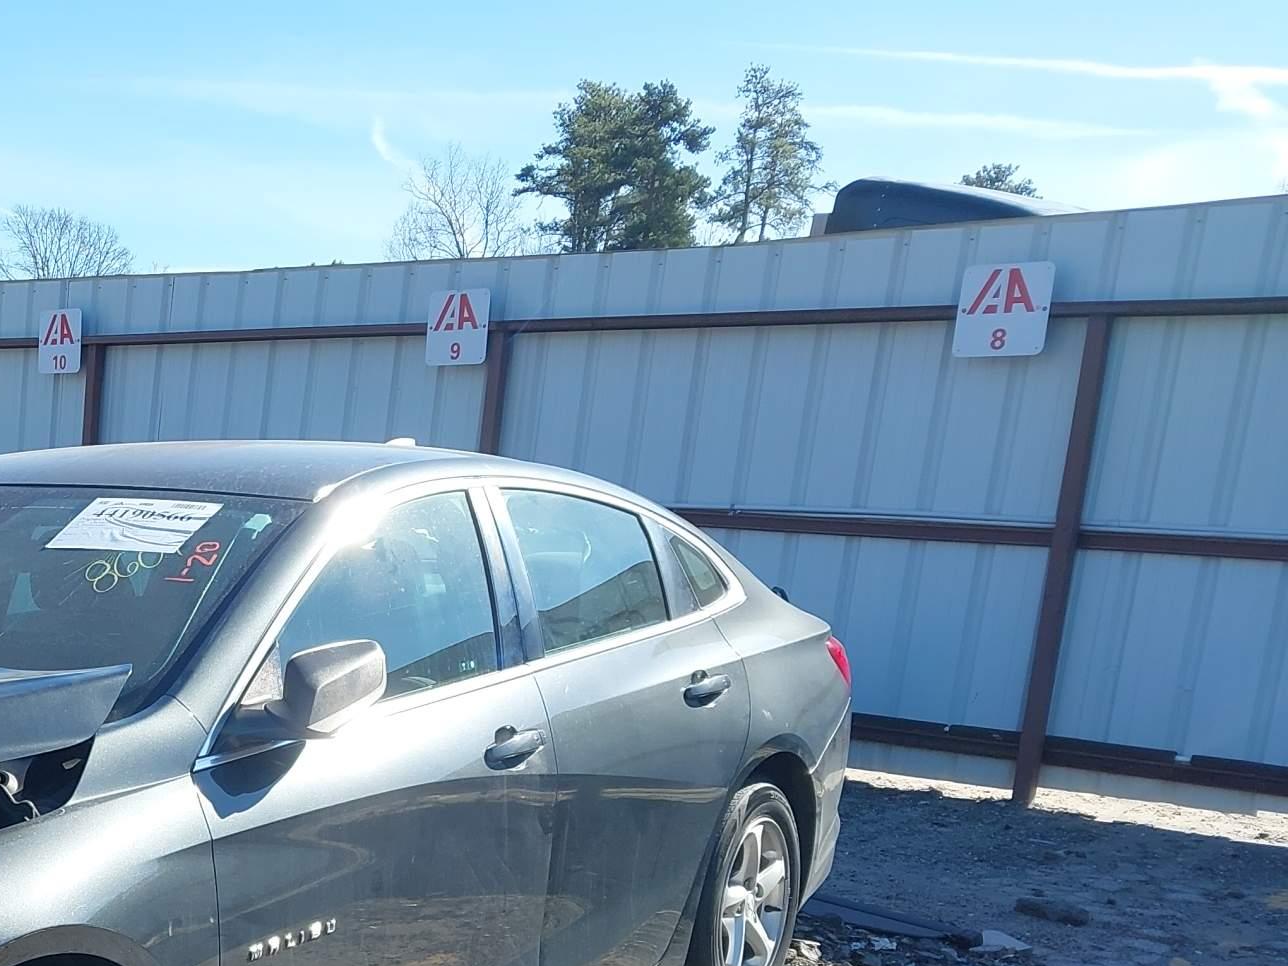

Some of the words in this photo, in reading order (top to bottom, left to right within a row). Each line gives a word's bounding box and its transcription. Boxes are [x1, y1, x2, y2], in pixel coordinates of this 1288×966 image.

[990, 328, 1007, 350] 8
[450, 342, 461, 360] 9
[53, 354, 67, 370] 10
[92, 507, 193, 523] 44190566
[163, 541, 221, 582] 1-20
[247, 918, 337, 961] MALIBU
